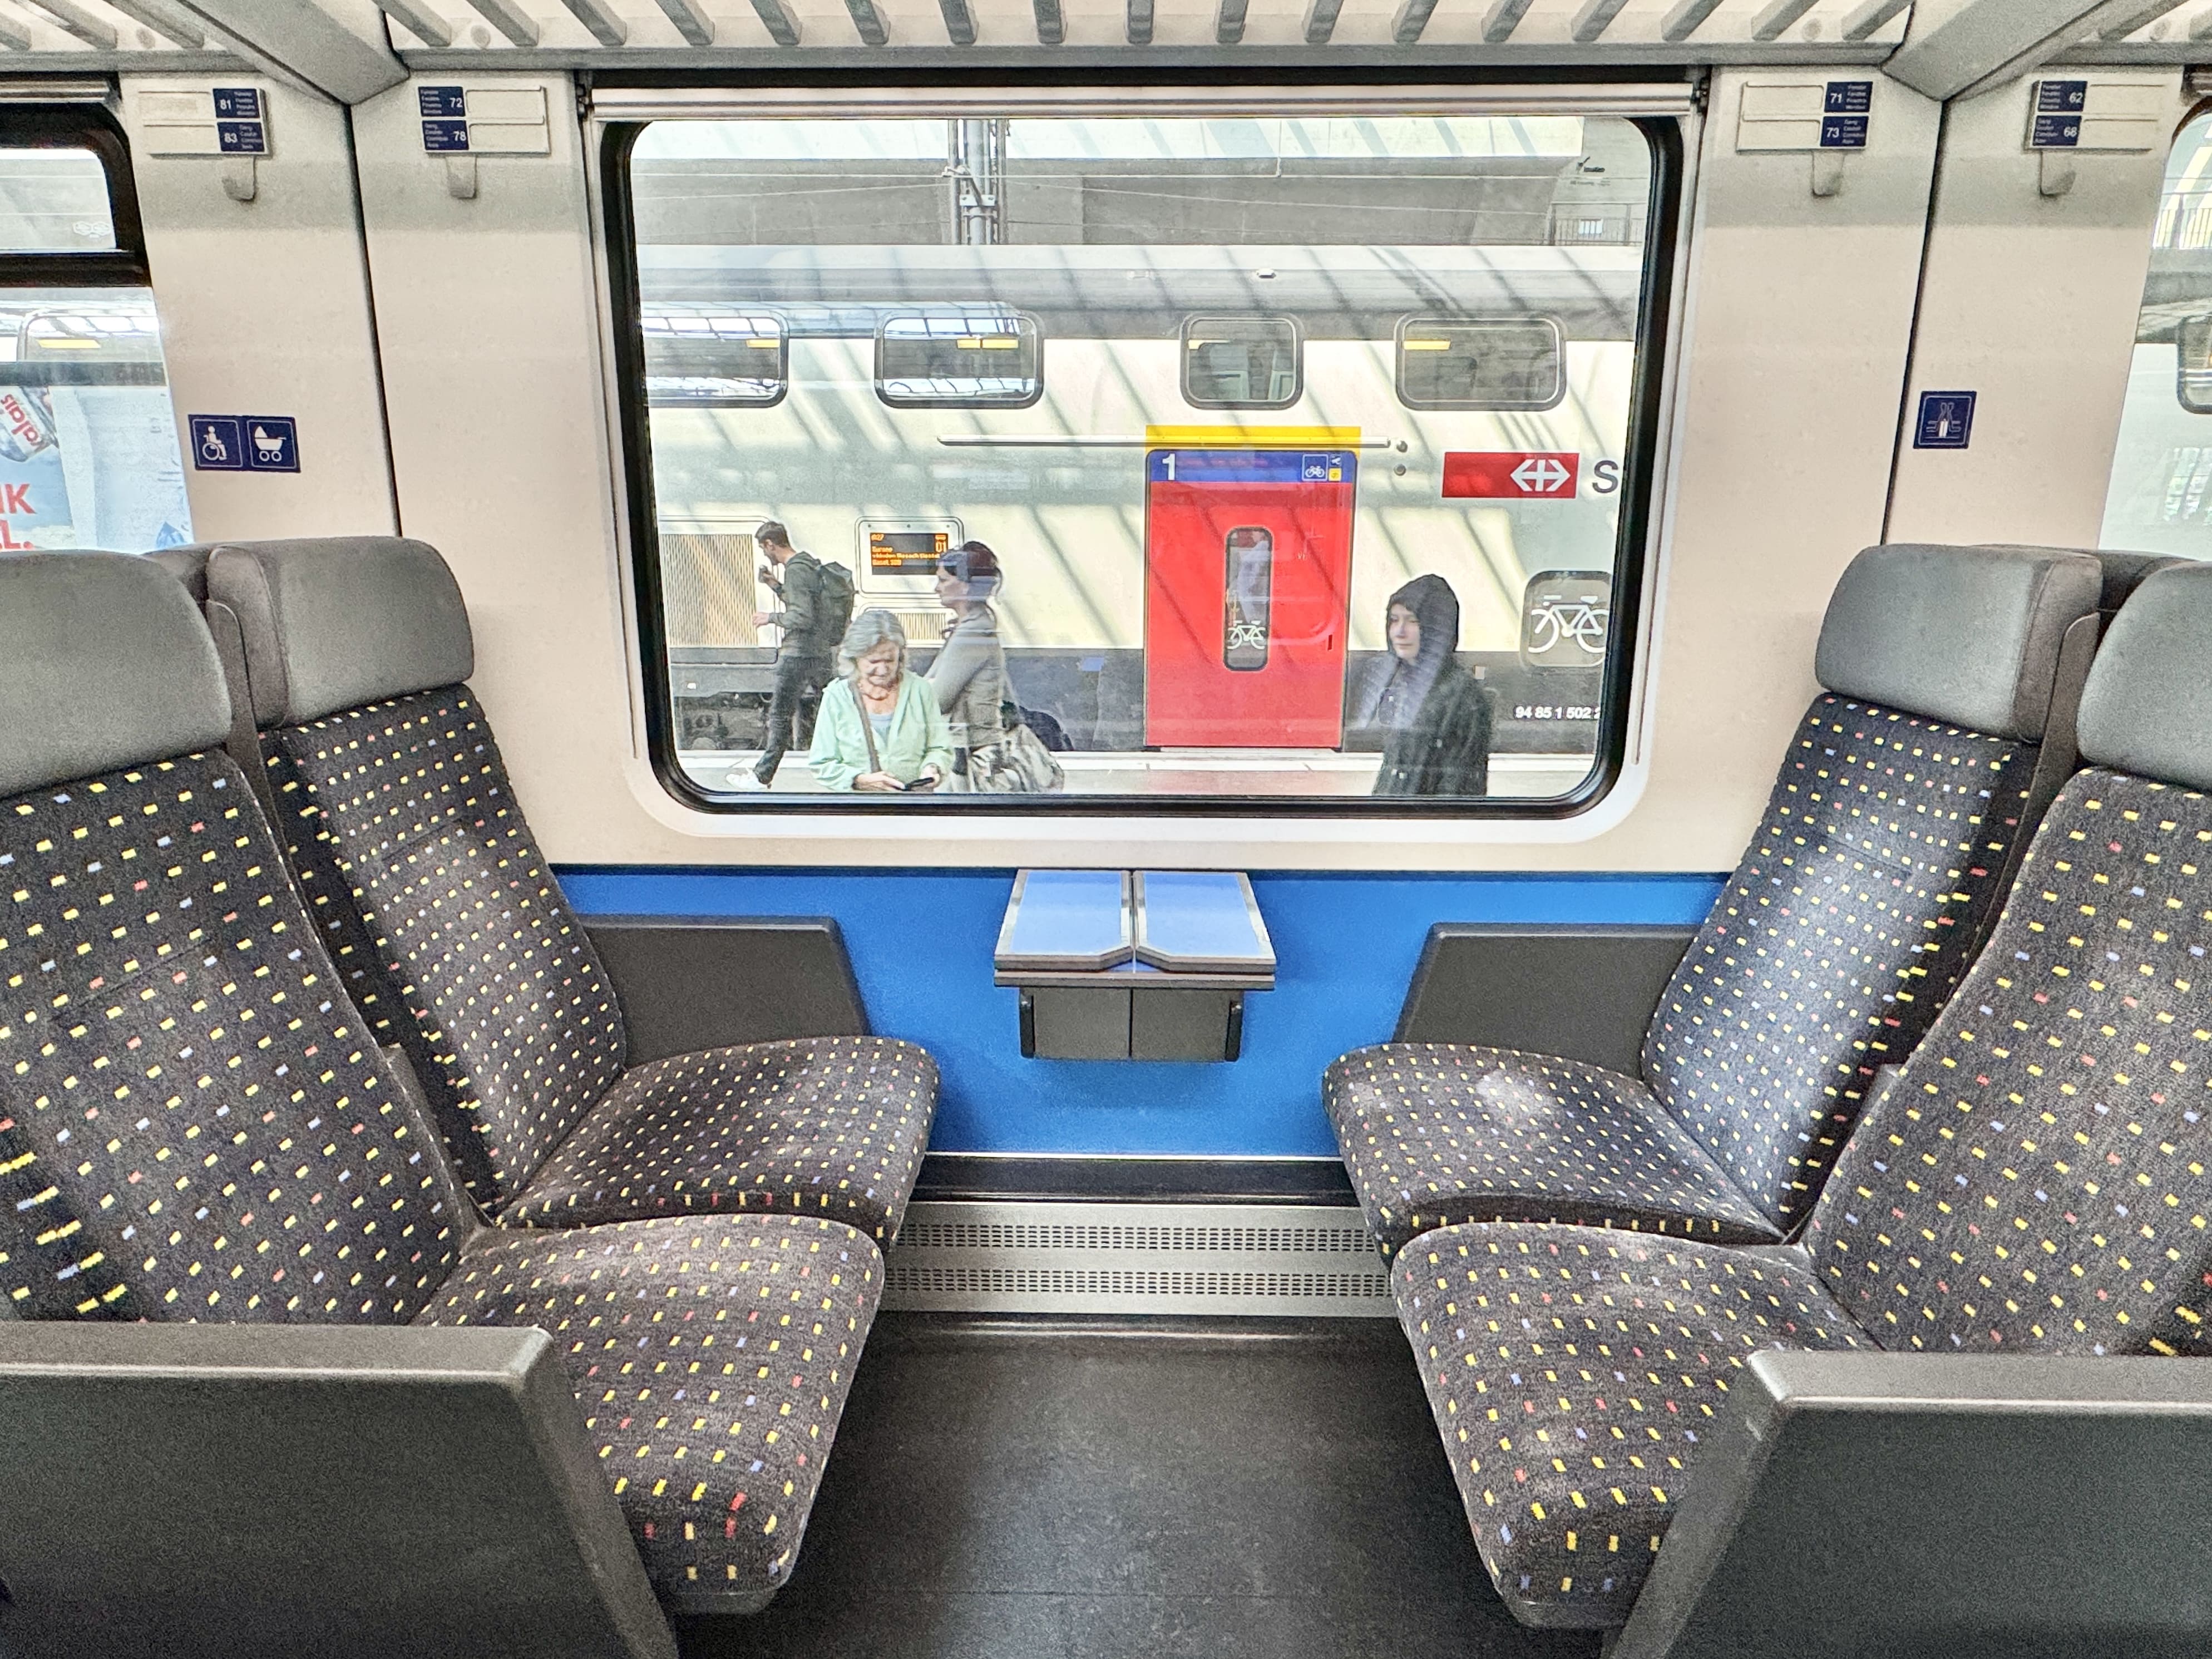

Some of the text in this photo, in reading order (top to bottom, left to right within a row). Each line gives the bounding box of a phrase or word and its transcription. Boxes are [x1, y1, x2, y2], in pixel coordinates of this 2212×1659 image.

[220, 98, 232, 110] 81
[449, 97, 463, 108] 72
[1830, 92, 1843, 104] 71
[2069, 92, 2083, 104] 62
[453, 131, 467, 142] 78
[1826, 127, 1840, 138] 73
[2063, 126, 2078, 137] 68
[1162, 453, 1176, 481] 1
[1515, 705, 1532, 719] 94
[1534, 705, 1553, 719] 85
[1566, 706, 1592, 719] 502
